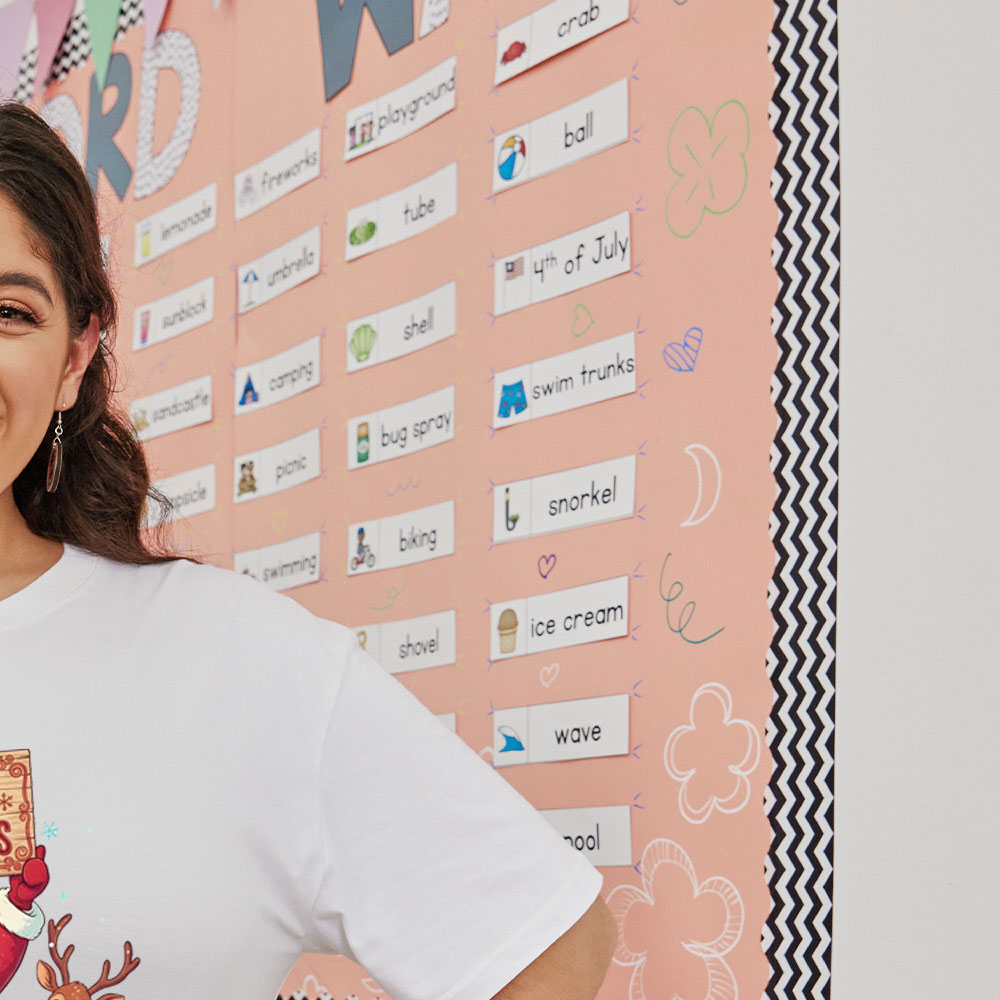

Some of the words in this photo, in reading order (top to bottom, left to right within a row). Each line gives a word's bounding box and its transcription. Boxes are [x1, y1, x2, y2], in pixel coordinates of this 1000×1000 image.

[556, 0, 601, 38] crab
[377, 66, 457, 132] playground
[563, 110, 594, 149] ball
[260, 147, 318, 194] fireworks
[160, 201, 213, 241] lemonade
[403, 195, 436, 226] tube
[267, 246, 315, 287] umbrella
[533, 250, 558, 284] 4th
[564, 244, 586, 276] of
[591, 230, 630, 265] July
[161, 292, 208, 329] sunblock
[403, 305, 435, 341] shell
[269, 361, 314, 392] camping
[532, 373, 575, 401] swim
[580, 352, 636, 387] trunks
[380, 424, 408, 449] bug
[412, 410, 452, 443] spray
[275, 455, 308, 485] picnic
[548, 474, 618, 517] snorkel
[399, 525, 438, 553] biking
[262, 554, 318, 583] swimming
[530, 616, 557, 639] ice
[563, 602, 625, 633] cream
[399, 626, 440, 661] shovel
[555, 724, 602, 745] wave
